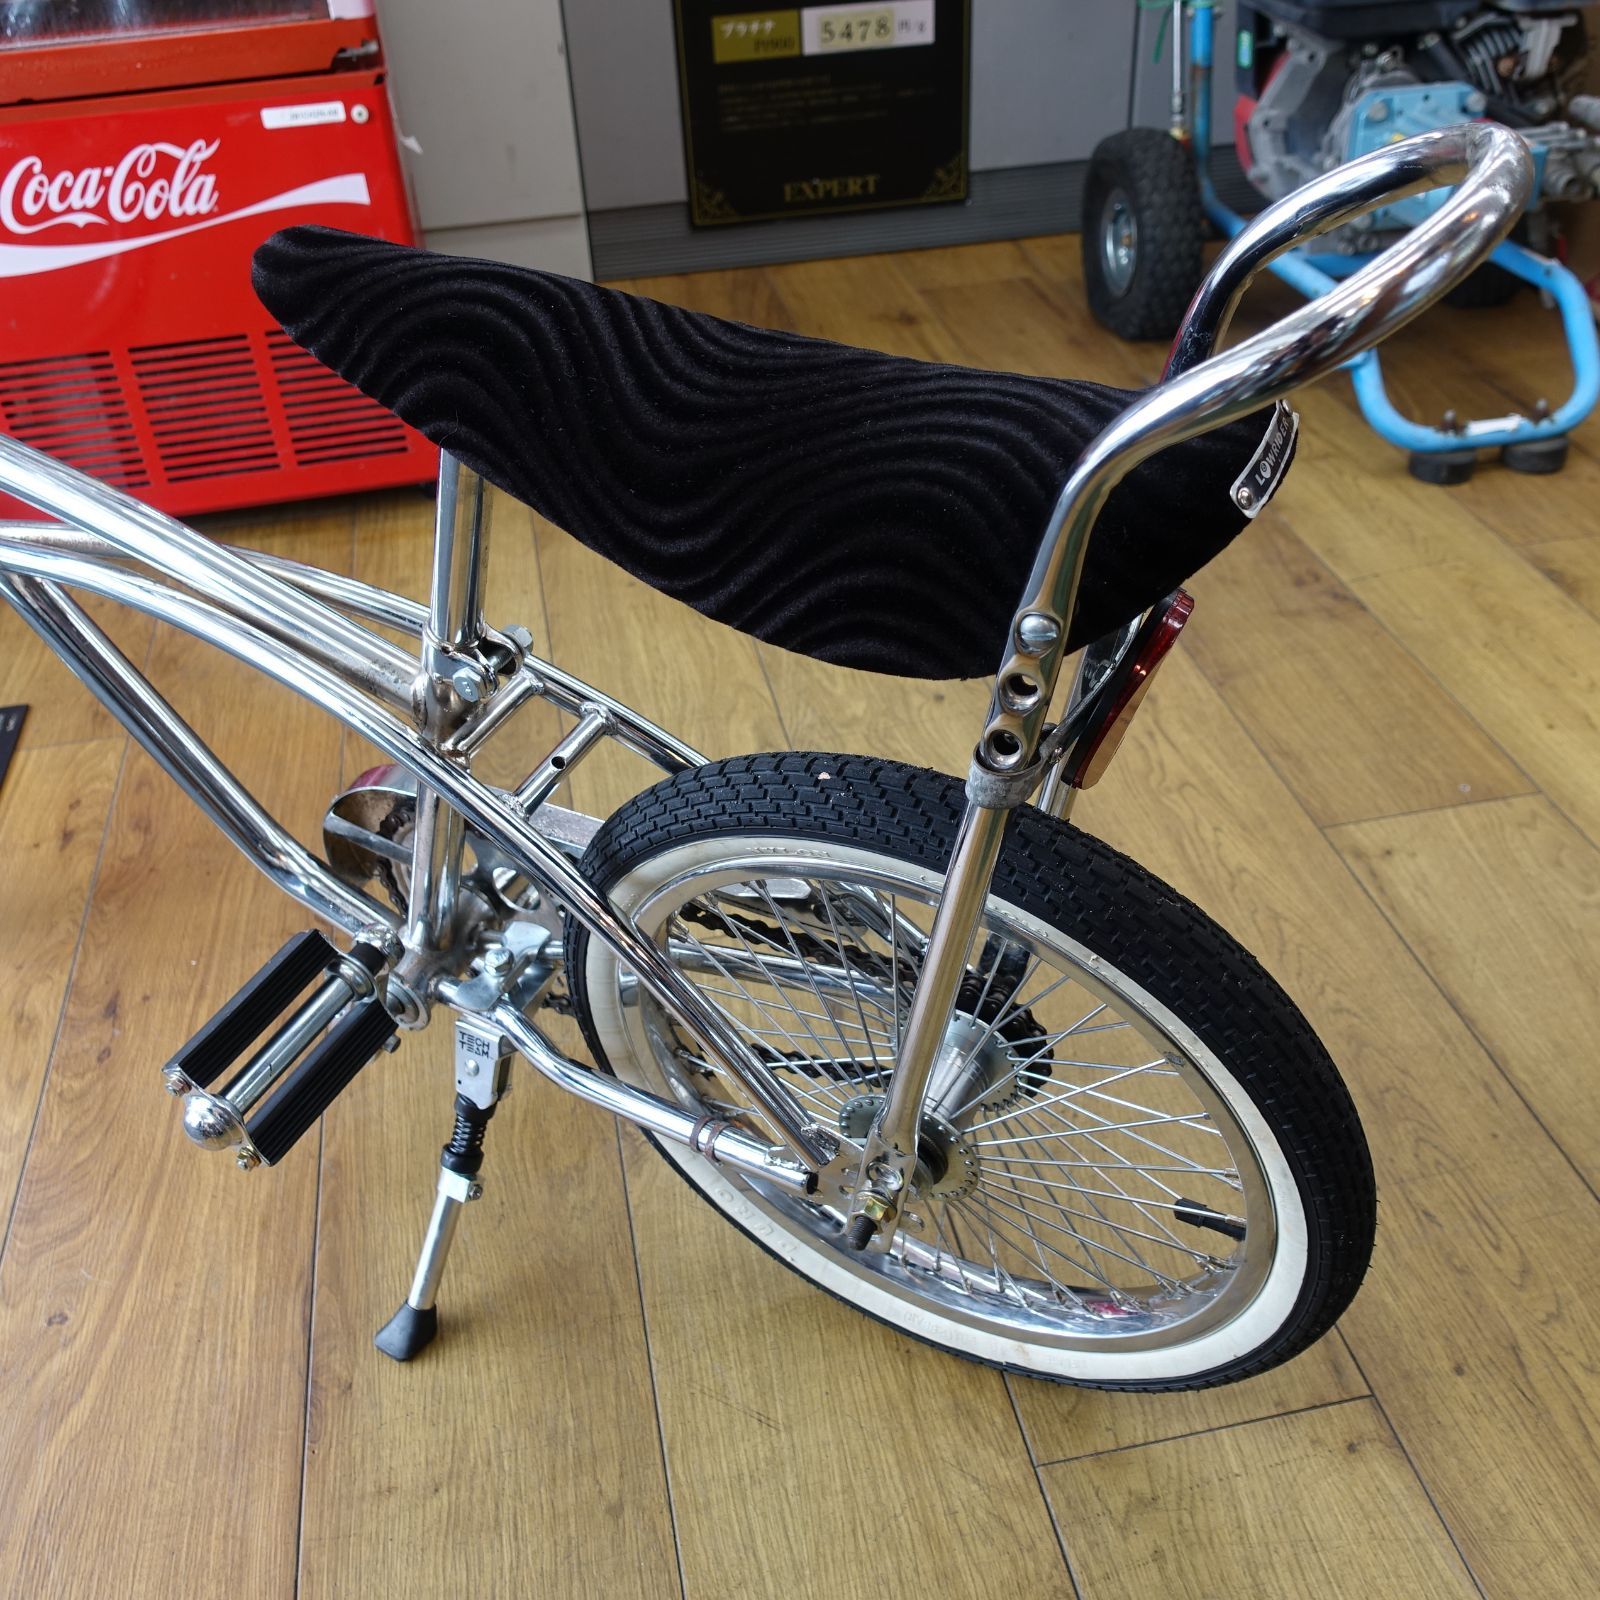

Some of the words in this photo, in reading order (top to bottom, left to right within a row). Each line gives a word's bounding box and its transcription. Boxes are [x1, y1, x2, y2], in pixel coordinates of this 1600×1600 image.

[820, 18, 893, 43] 5478
[0, 137, 220, 235] Coca-Cola
[783, 174, 880, 203] EXPERT
[1254, 416, 1290, 486] LOWRIDER
[458, 1030, 490, 1052] TECH
